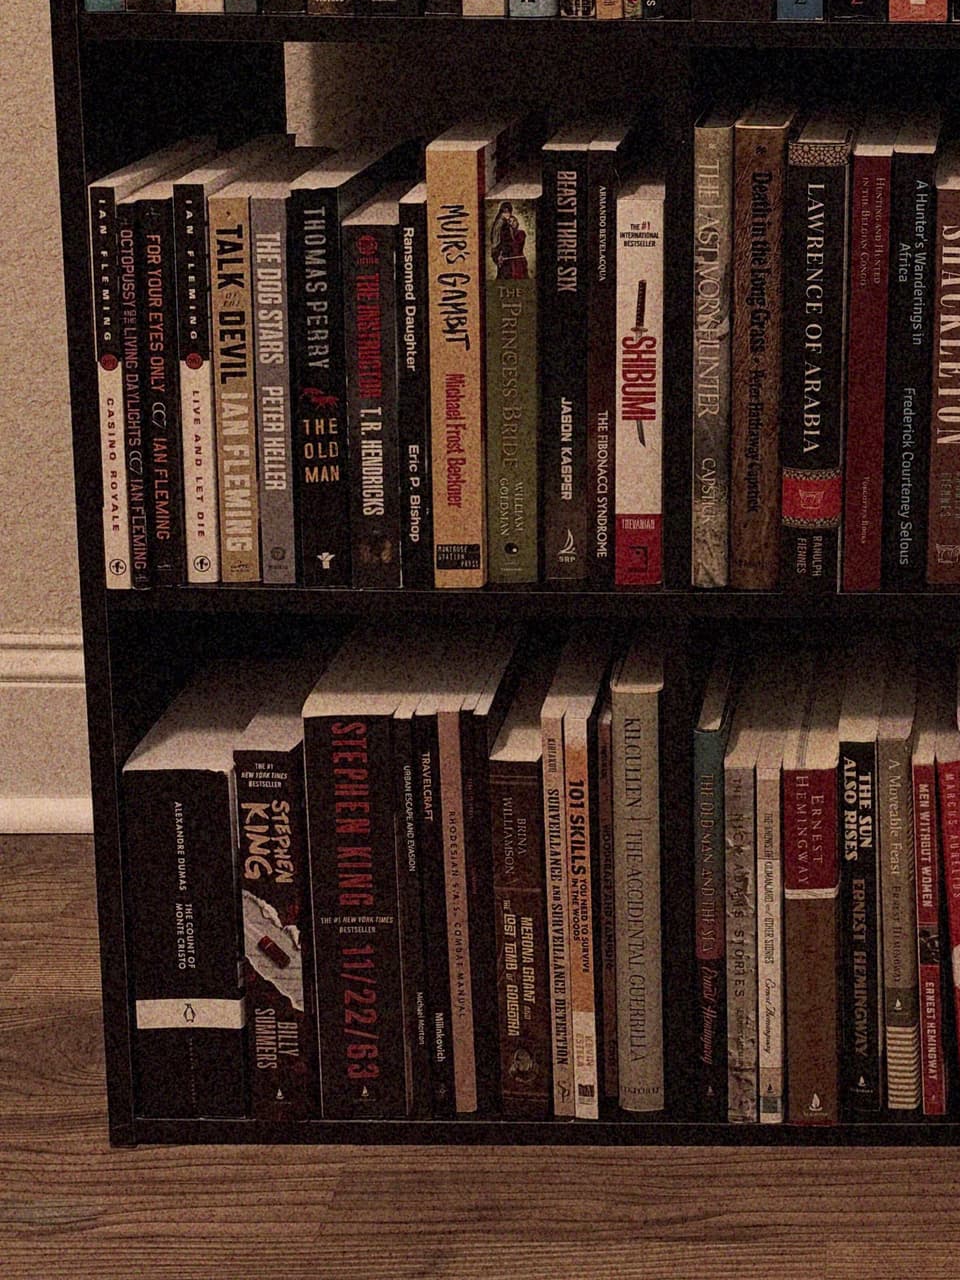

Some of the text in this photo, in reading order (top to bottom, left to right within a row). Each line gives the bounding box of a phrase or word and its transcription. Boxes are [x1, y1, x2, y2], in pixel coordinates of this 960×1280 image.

[216, 225, 245, 289] TALK
[256, 232, 284, 365] THE DOG STARS
[303, 207, 329, 369] THOMAS PERRY
[898, 243, 911, 283] Africa
[146, 235, 166, 392] FOR YOUR EYES ONLY
[219, 311, 247, 384] DEVIL
[803, 184, 825, 453] LAWRENCE OF ARABIA
[621, 336, 656, 421] SHIBUMI
[106, 398, 119, 531] CASINO ROYALE
[261, 386, 286, 490] PETER HELLER
[303, 419, 338, 435] THE
[304, 443, 339, 459] OLD
[305, 466, 339, 483] MAN
[624, 719, 641, 807] KILCULLEN
[944, 773, 956, 824] MARCUS
[241, 802, 272, 879] KING
[272, 800, 293, 883] STEPHEN
[331, 722, 374, 906] STEPHEN KING
[569, 781, 586, 875] 101 SKILLS
[843, 757, 858, 862] ALSO RISES
[858, 772, 872, 848] THE SUN
[919, 784, 932, 908] MEN WITHOUT WOMEN
[175, 904, 186, 970] MONTE CRISTO
[521, 917, 535, 1003] MERONA GRANT
[277, 1022, 299, 1056] BILLY
[853, 951, 868, 1058] HEMINGWAY
[925, 982, 936, 1080] ERNEST HEMINGWAY
